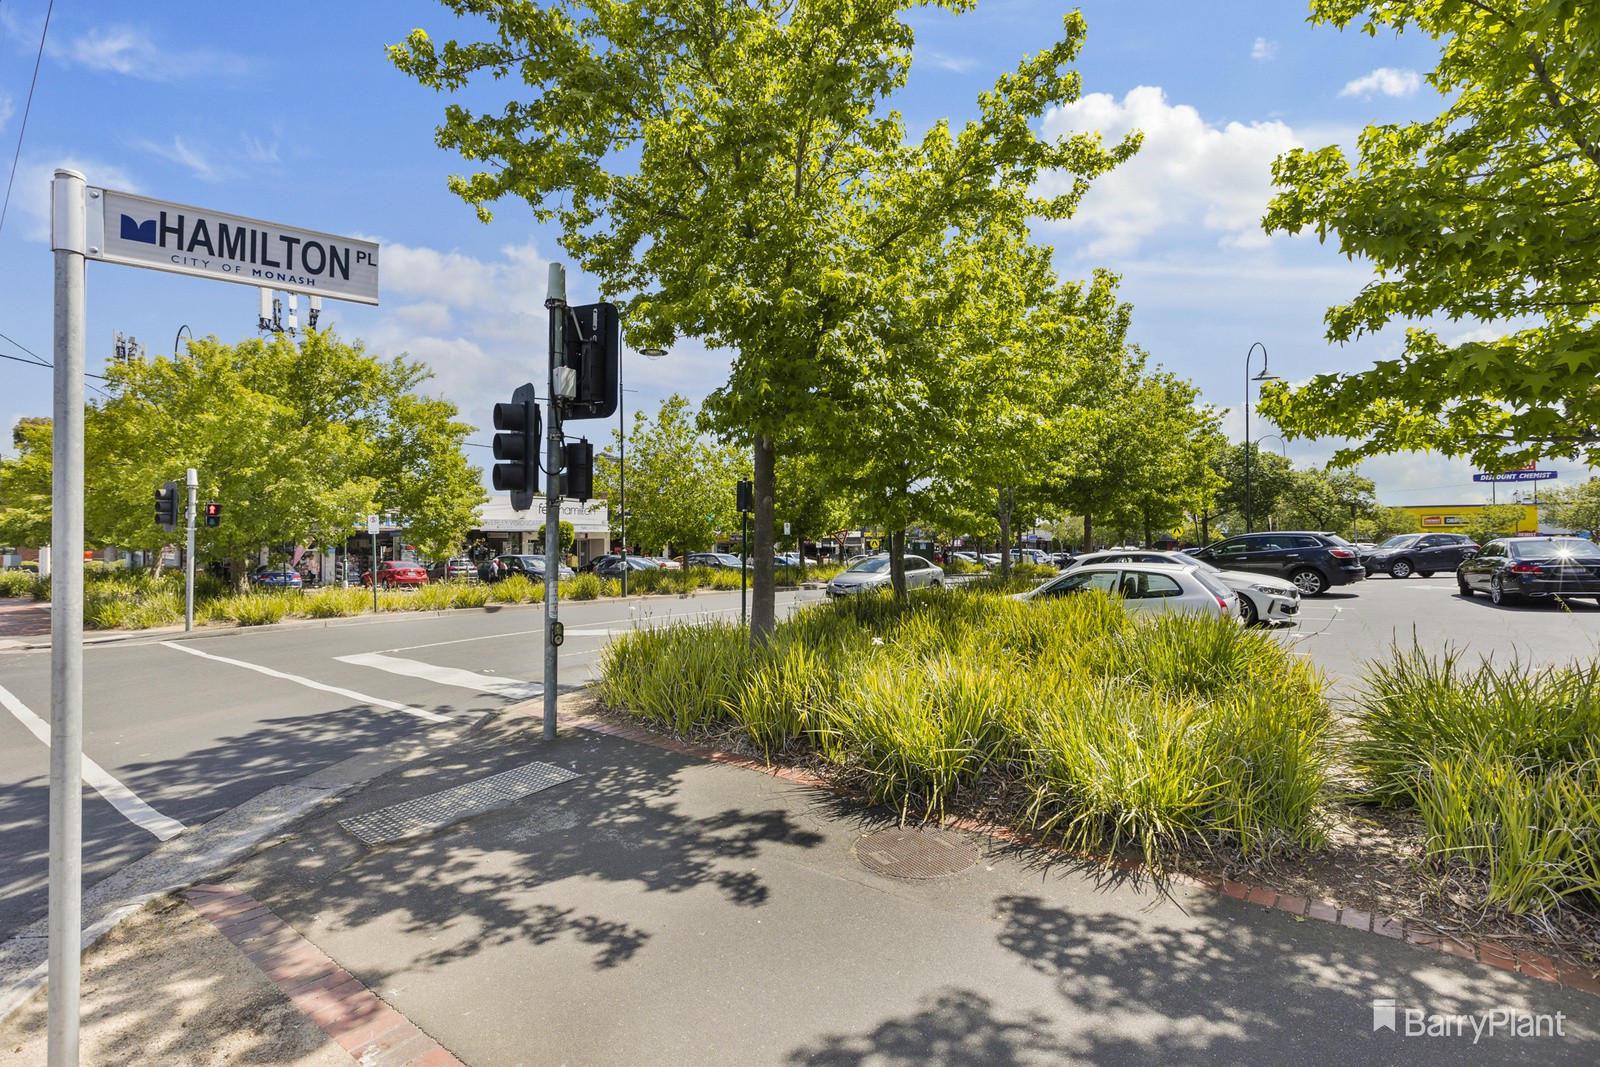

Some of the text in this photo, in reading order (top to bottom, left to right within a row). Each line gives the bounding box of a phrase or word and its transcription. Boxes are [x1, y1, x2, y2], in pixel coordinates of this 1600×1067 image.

[159, 211, 377, 281] HAMILTON PL
[171, 254, 316, 286] CITY OF MONASH
[1480, 473, 1517, 481] DISOUNT
